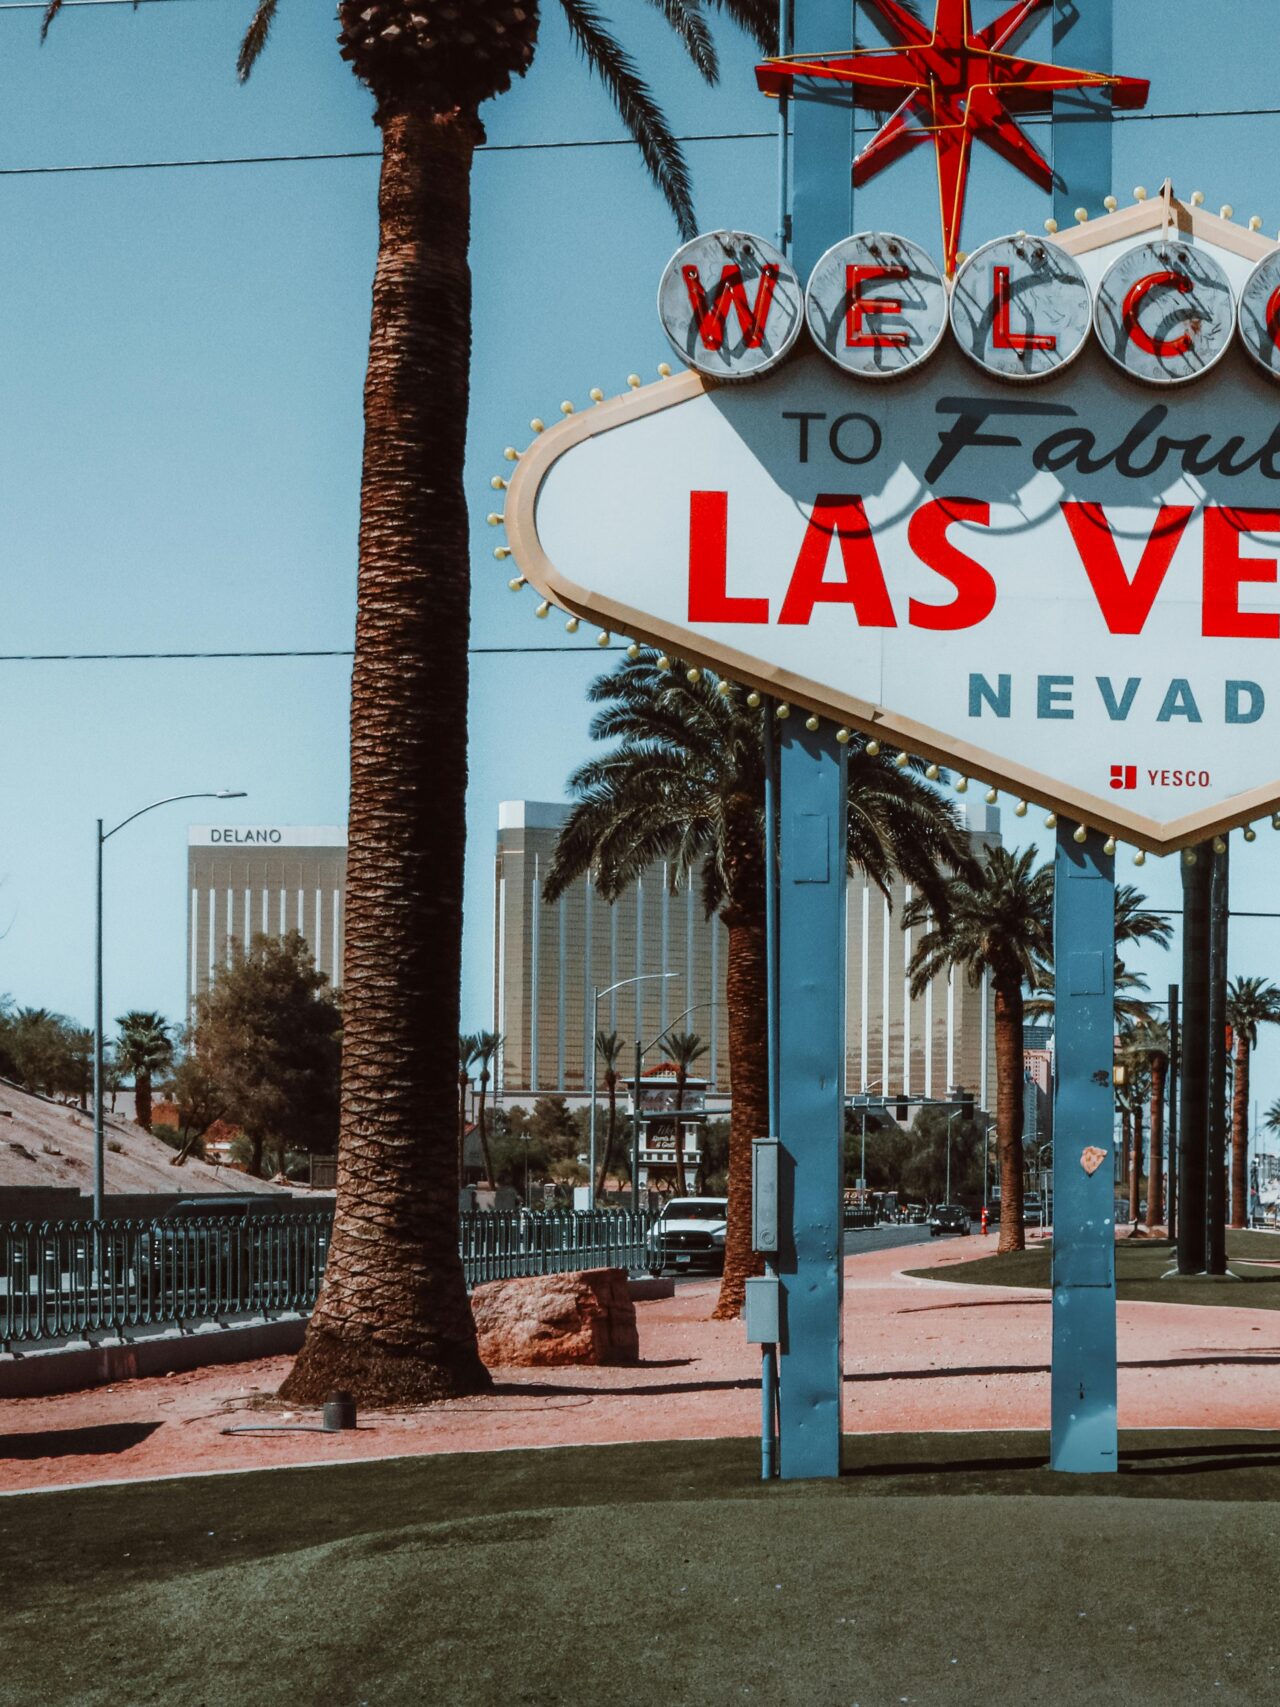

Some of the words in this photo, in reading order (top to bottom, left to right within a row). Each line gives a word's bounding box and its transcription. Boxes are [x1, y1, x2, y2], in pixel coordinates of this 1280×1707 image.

[782, 411, 883, 465] TO
[688, 490, 996, 631] LAS
[1148, 769, 1209, 787] YESCO
[211, 829, 281, 843] DELANO
